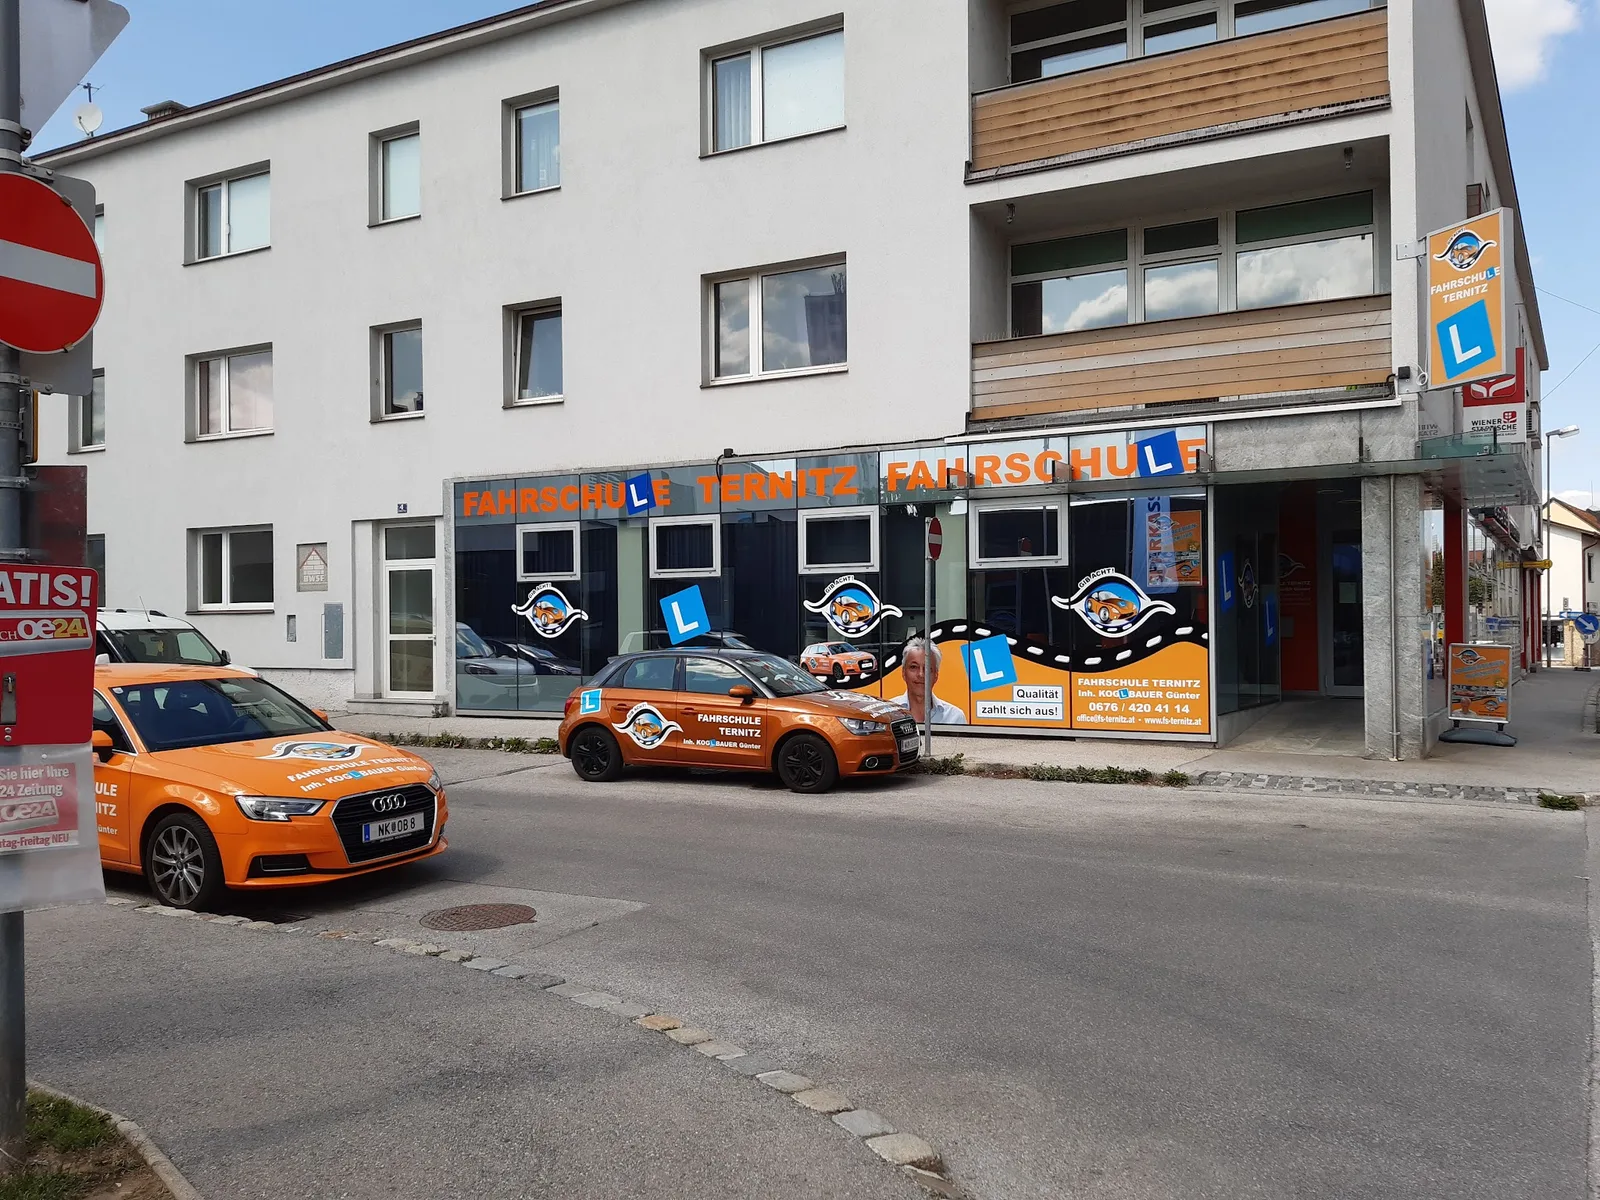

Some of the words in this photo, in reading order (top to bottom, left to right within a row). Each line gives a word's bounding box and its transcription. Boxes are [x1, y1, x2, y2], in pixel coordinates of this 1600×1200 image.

[1431, 267, 1500, 296] FAHRSCHULE
[1443, 283, 1488, 303] TERNITZ
[1449, 324, 1482, 364] L
[1471, 418, 1502, 426] WIENER
[463, 479, 671, 517] FAHRSCHULE
[697, 465, 859, 504] TERNITZ
[887, 438, 1206, 491] FAHRSCHULE
[825, 583, 834, 593] GIB
[835, 576, 854, 584] ACHT!
[1079, 577, 1090, 587] GIB
[1091, 568, 1114, 579] ACHT!
[671, 601, 699, 634] L
[17, 618, 86, 640] oe24
[973, 648, 1004, 682] L
[1078, 678, 1149, 687] FAHRSCHULE
[1152, 679, 1200, 688] TERNITZ
[1016, 688, 1058, 699] Qualität
[1098, 689, 1163, 699] KOGLBAUER
[1166, 691, 1200, 699] Günter
[585, 694, 595, 709] L
[1089, 702, 1118, 712] 0676
[1128, 703, 1151, 712] 420
[1155, 704, 1169, 713] 41
[1175, 704, 1190, 713] 14
[981, 705, 1006, 714] zahlt
[1009, 706, 1031, 715] sich
[1035, 706, 1058, 716] aus!
[697, 713, 761, 725] FAHRSCHULE
[1076, 713, 1135, 724] office@fs-ternitz.at
[1144, 716, 1202, 726] www.fs-ternitz.at
[719, 727, 761, 737] TERNITZ
[696, 739, 738, 748] KOGLBAUER
[739, 742, 761, 750] Günter
[0, 768, 17, 780] Sie
[20, 766, 43, 779] hier
[46, 765, 70, 777] Ihre
[287, 761, 370, 782] FAHRSCHULE
[300, 781, 325, 792] Inh.
[326, 767, 395, 784] KOGLBAUER
[0, 784, 15, 797] 24
[17, 783, 63, 797] Zeitung
[95, 802, 117, 816] ITZ
[98, 825, 118, 835] ünter
[378, 823, 391, 836] NK
[52, 834, 69, 844] NEU
